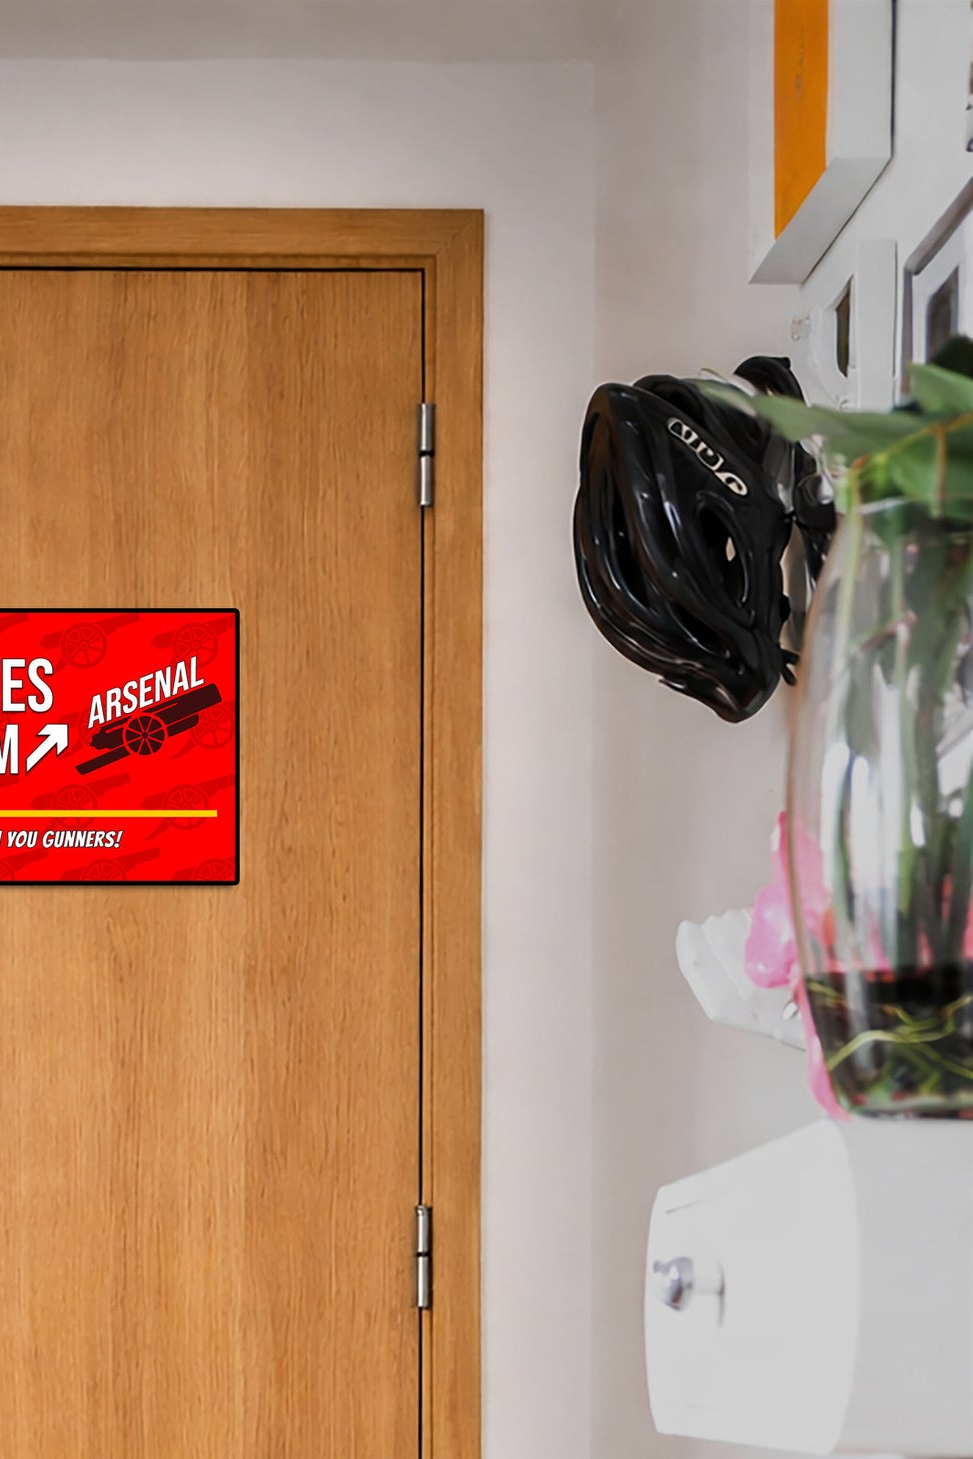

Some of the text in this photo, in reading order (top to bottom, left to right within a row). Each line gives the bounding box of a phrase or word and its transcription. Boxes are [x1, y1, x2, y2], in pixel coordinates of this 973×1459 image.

[87, 656, 205, 729] ARSENAL
[7, 830, 39, 849] YOU
[42, 830, 124, 849] GUNNERS!
